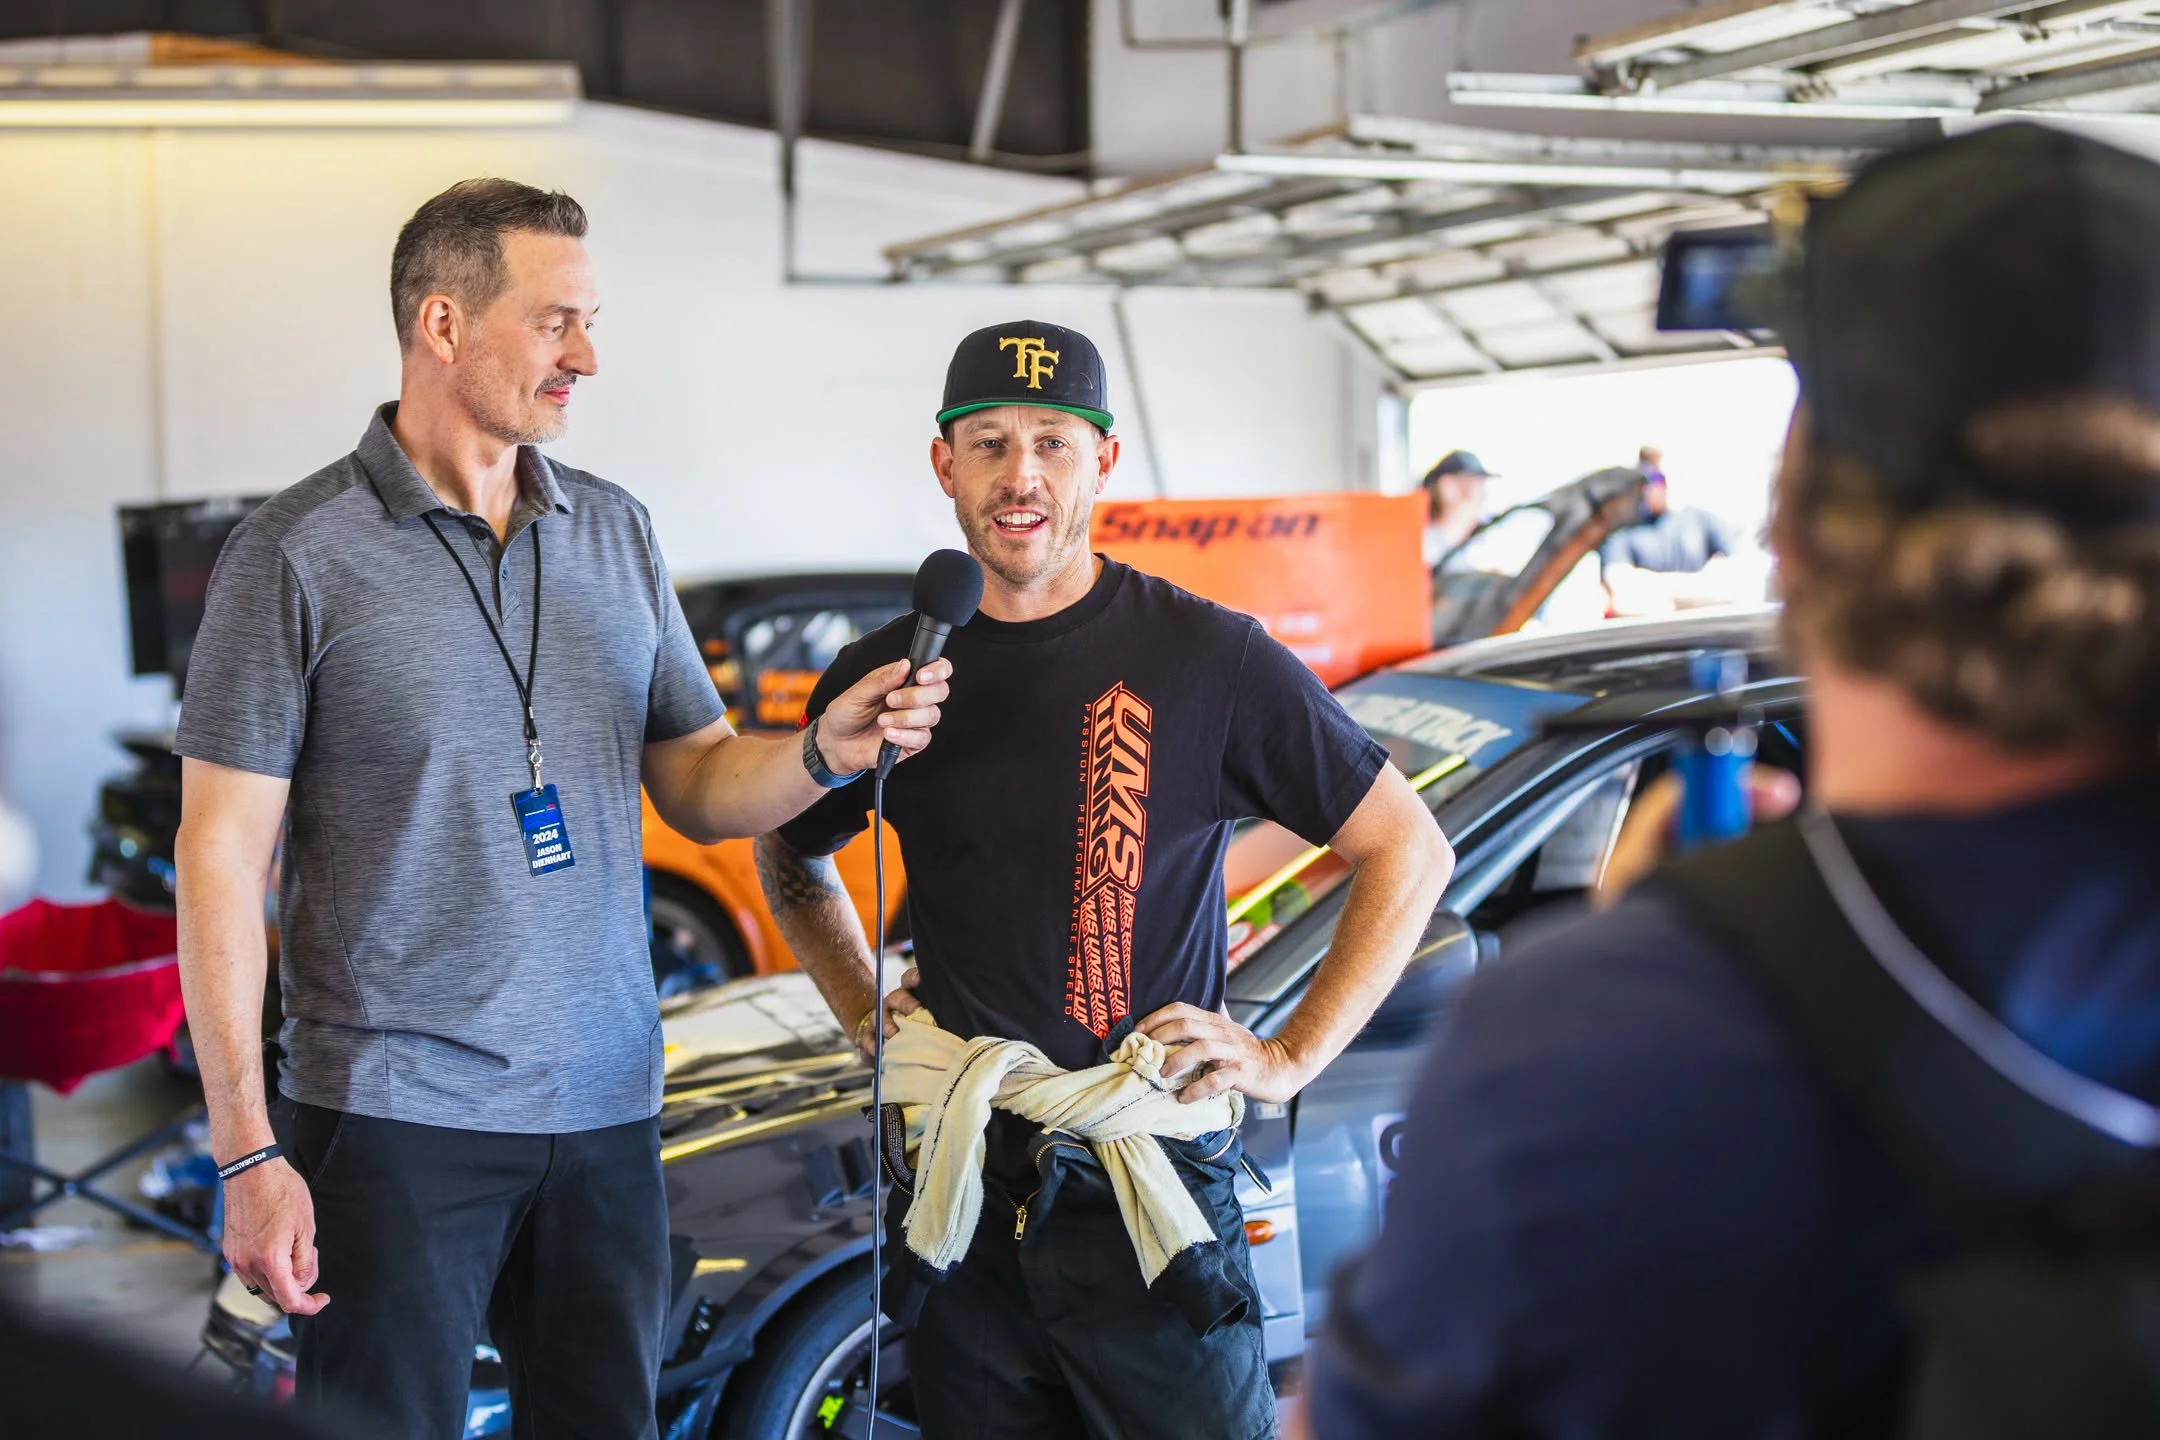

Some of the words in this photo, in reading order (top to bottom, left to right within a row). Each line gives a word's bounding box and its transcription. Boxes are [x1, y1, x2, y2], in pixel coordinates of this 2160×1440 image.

[999, 336, 1060, 390] TF
[1095, 504, 1320, 547] Snap-on
[1090, 693, 1115, 879] TUNING
[1108, 692, 1151, 890] UMS
[532, 828, 559, 845] 2024
[536, 843, 562, 858] JASON
[532, 851, 571, 868] DIENHART
